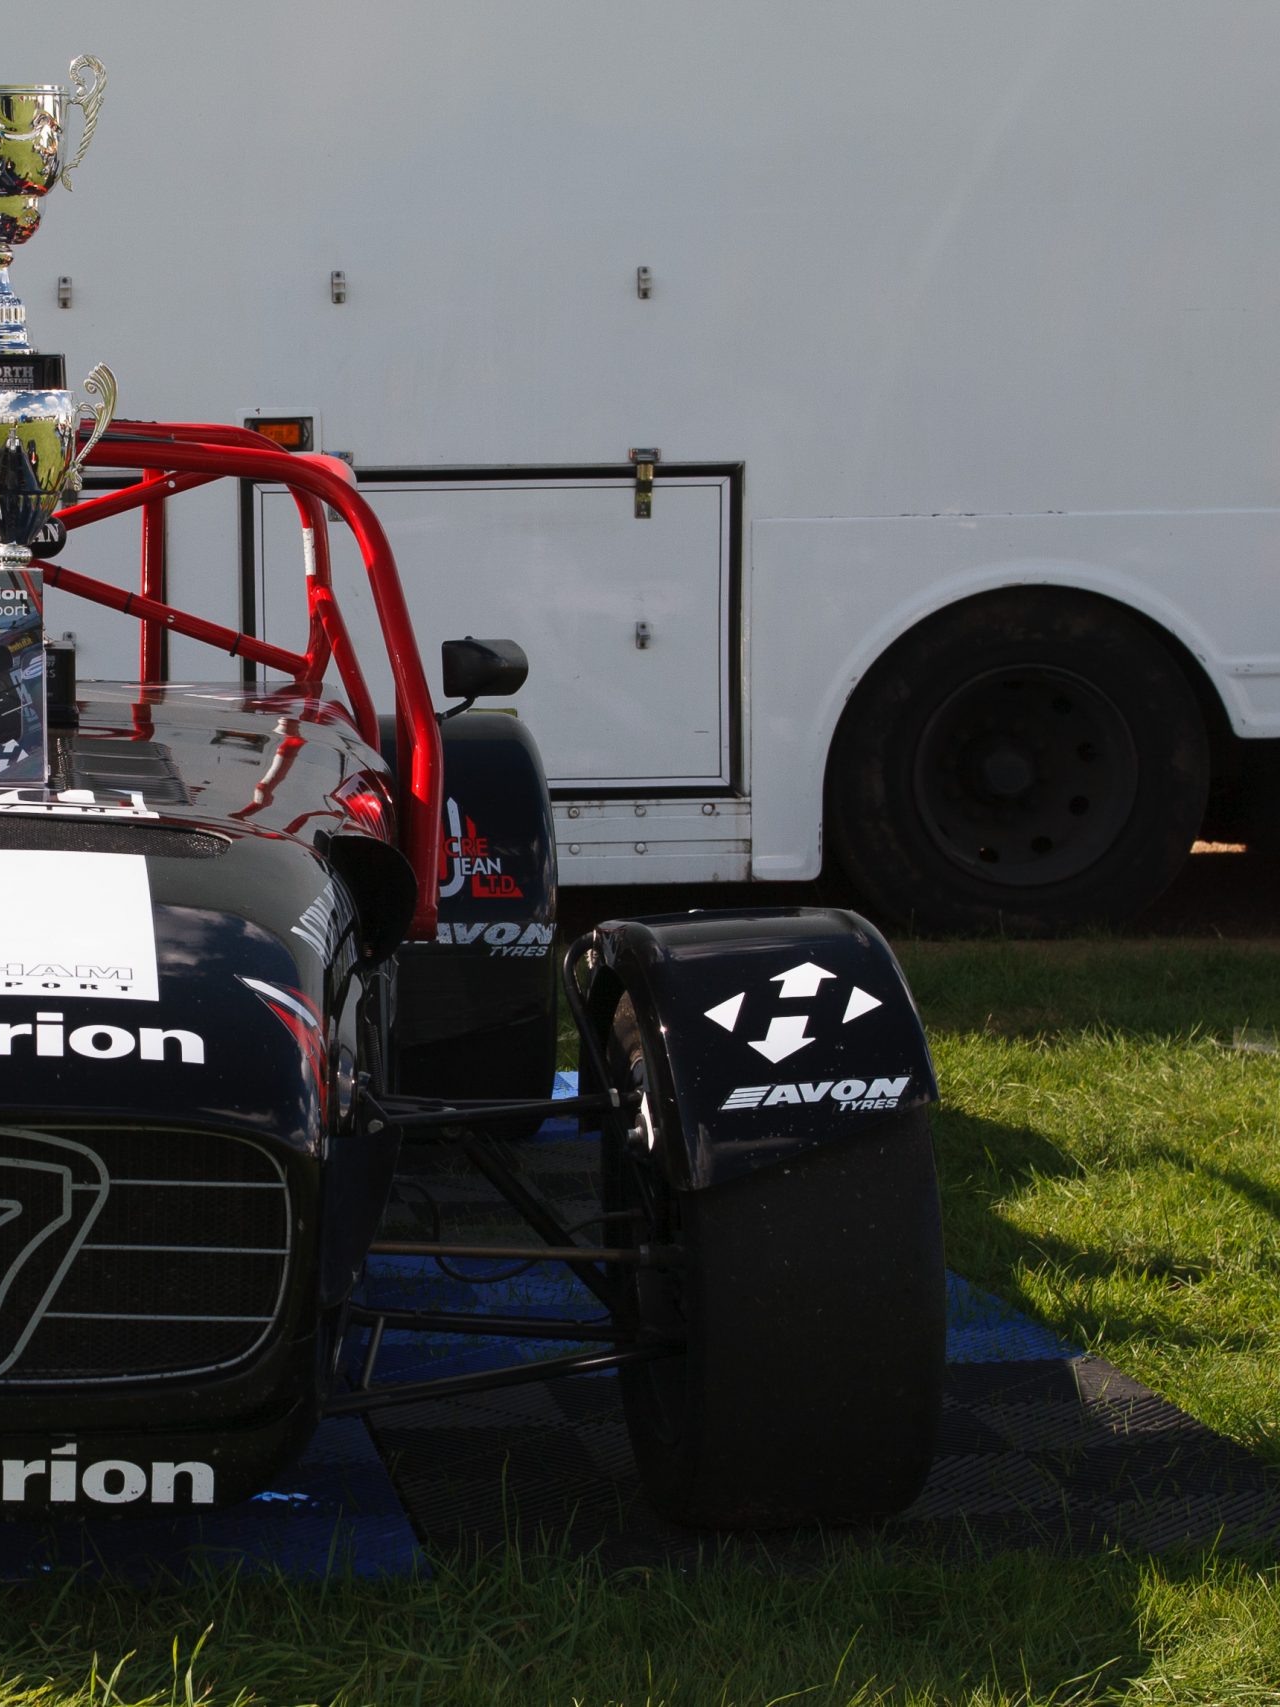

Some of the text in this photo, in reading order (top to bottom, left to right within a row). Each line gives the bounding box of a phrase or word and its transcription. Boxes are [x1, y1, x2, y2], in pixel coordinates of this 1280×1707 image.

[436, 922, 557, 946] AVON
[489, 945, 549, 957] TYRES
[762, 1076, 912, 1106] AVON
[838, 1098, 900, 1112] TYRES
